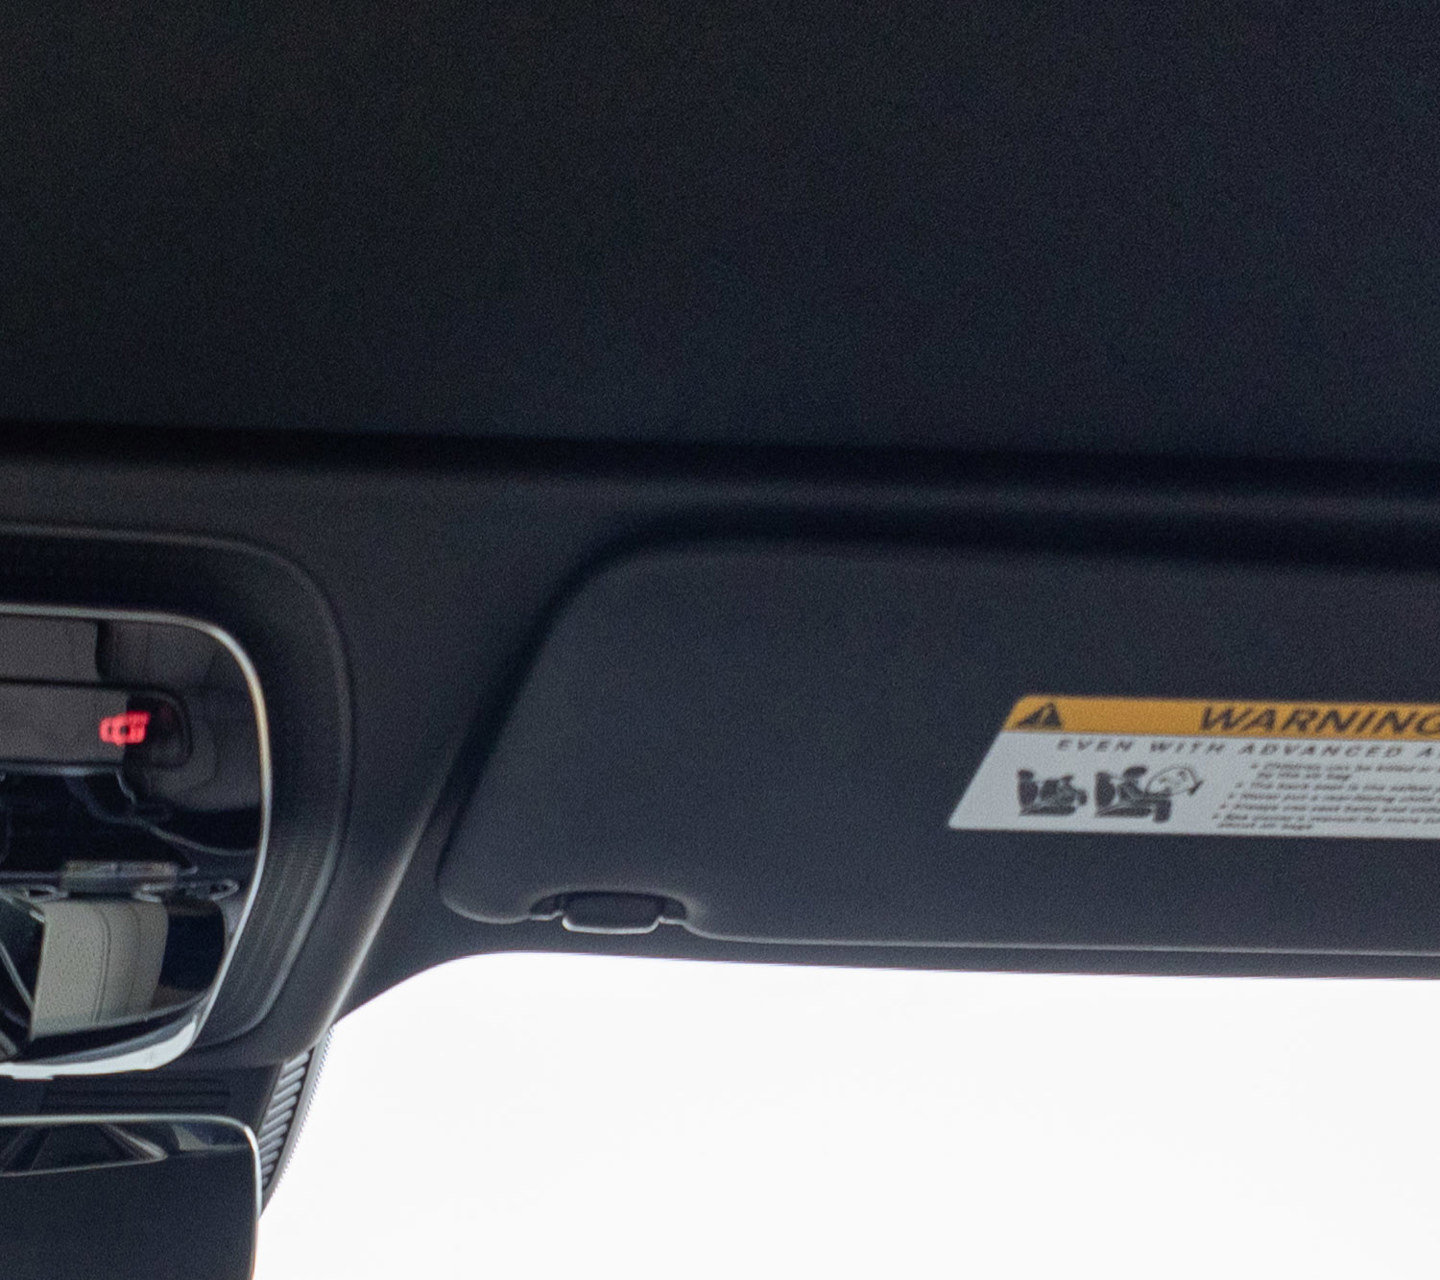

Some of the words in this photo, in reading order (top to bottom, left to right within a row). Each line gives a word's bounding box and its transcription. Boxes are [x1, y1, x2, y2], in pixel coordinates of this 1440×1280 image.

[1056, 738, 1132, 752] EVEN
[1149, 741, 1225, 755] WITH
[1240, 744, 1402, 759] ADVANCED
